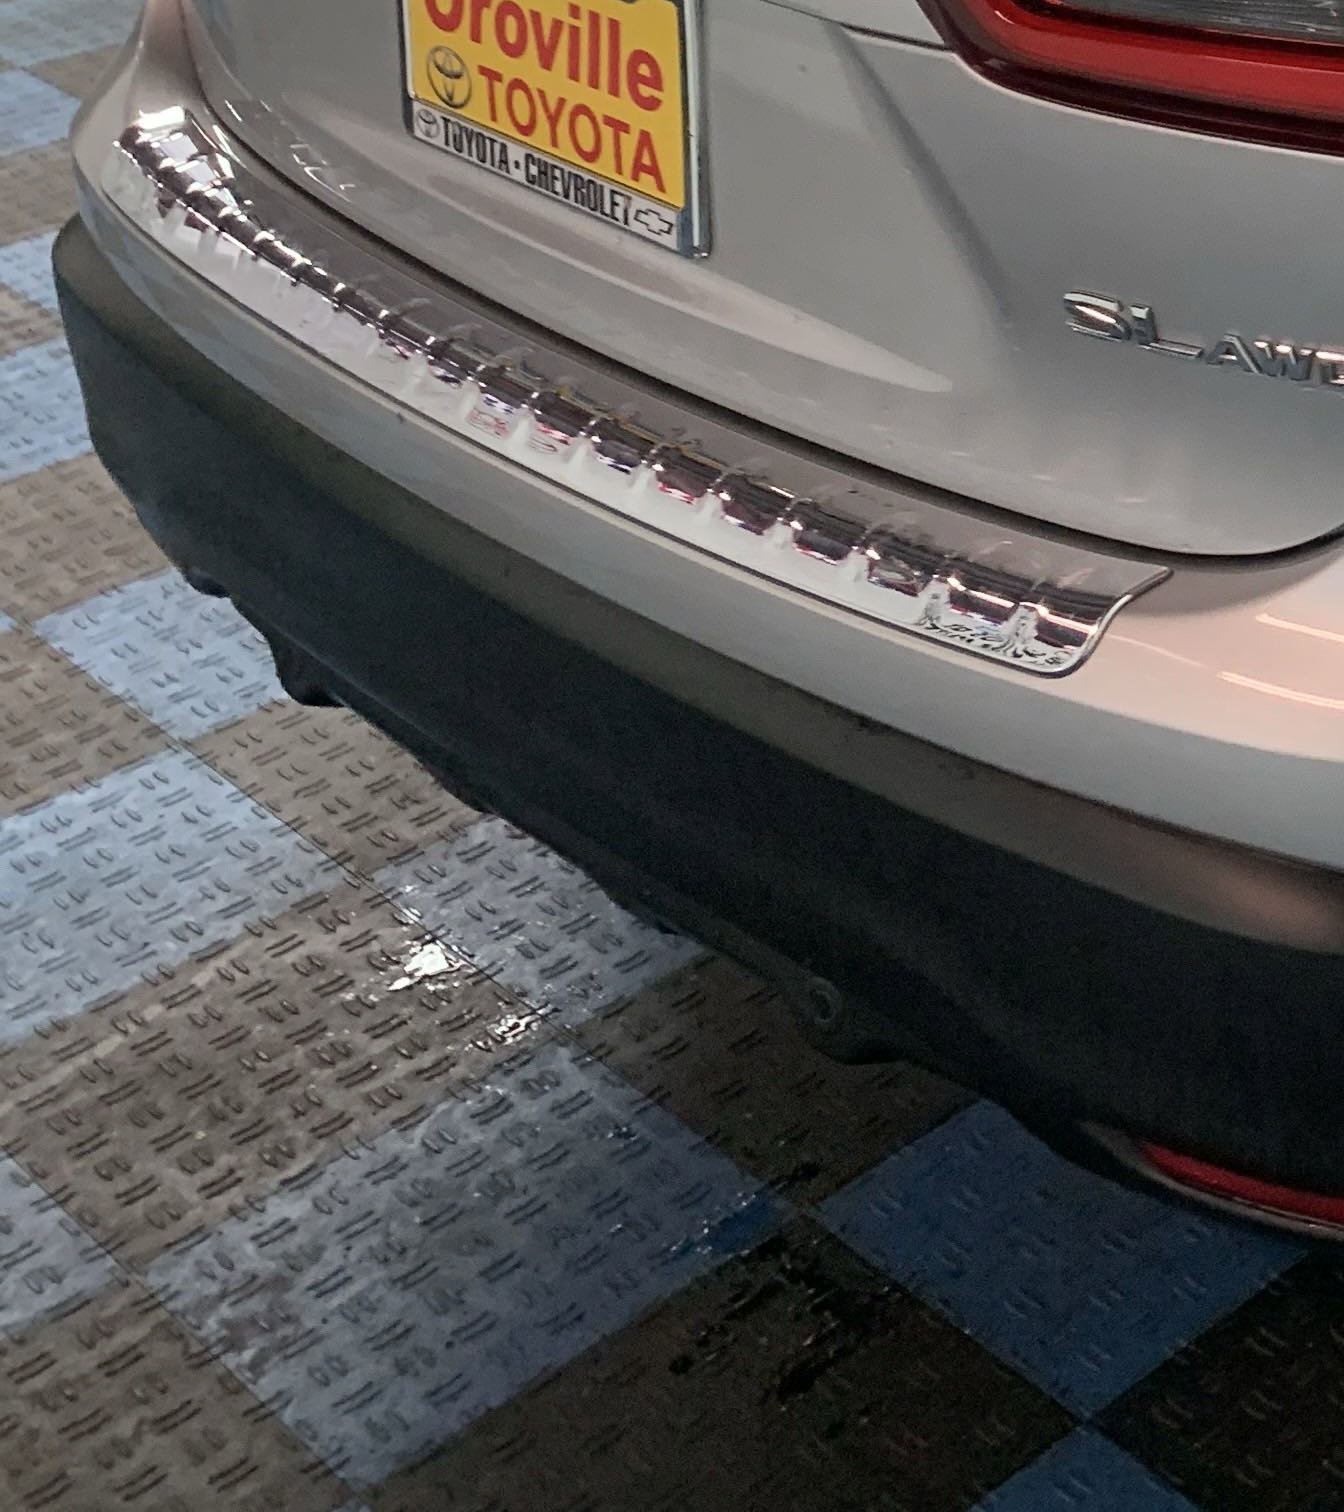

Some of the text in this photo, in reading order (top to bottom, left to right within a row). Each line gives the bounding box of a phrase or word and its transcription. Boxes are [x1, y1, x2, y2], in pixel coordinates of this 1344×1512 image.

[441, 117, 632, 226] TOYOTA CHEVROLET
[478, 65, 667, 193] TOYOTA
[1062, 290, 1204, 360] SL
